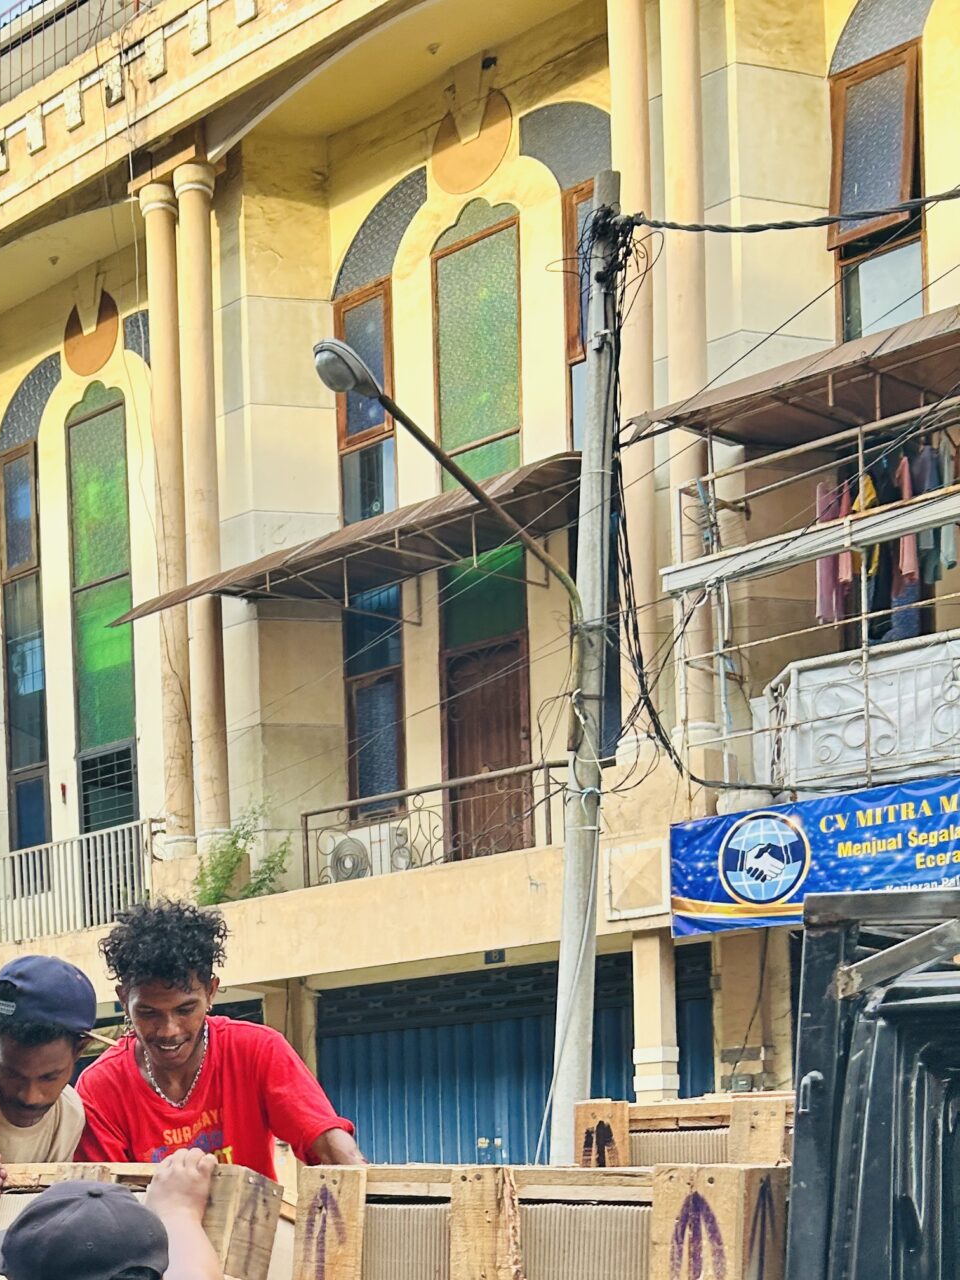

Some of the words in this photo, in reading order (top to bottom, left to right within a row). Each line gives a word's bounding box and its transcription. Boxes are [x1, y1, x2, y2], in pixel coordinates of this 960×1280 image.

[819, 812, 851, 834] CV
[856, 799, 933, 829] MITRA
[837, 833, 903, 858] Menjual
[908, 824, 960, 848] Segala
